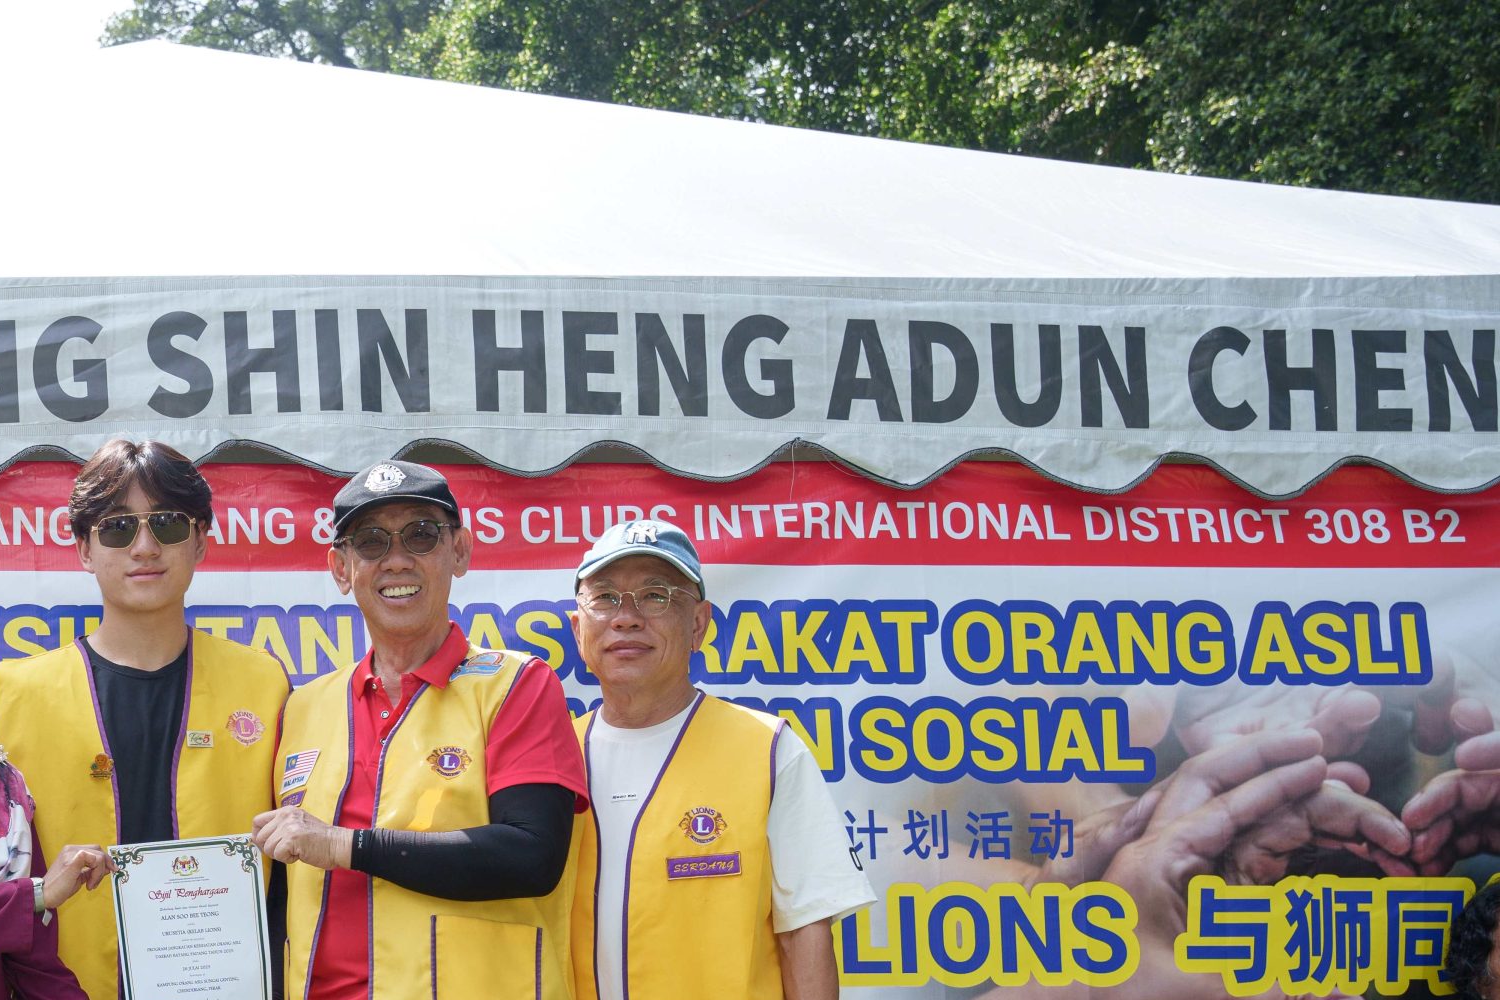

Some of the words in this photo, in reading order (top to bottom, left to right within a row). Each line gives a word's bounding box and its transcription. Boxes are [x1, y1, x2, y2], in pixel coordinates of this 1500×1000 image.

[147, 309, 431, 420] SHIN
[472, 309, 796, 421] HENG
[827, 318, 1150, 430] ADUN
[695, 501, 1071, 543] INTERNATIONAL
[1084, 504, 1290, 545] DISTRICT
[1304, 508, 1391, 545] 308
[1404, 508, 1467, 544] B2
[951, 609, 1227, 677] ORANG
[1249, 611, 1422, 676] ASLI
[443, 754, 456, 769] L
[860, 707, 1145, 772] SOSIAL
[691, 807, 716, 816] LIONS
[696, 816, 710, 834] L
[845, 810, 1074, 861] 计划活动
[673, 859, 735, 873] SERDANG
[175, 886, 229, 900] Penghargaan
[841, 894, 1128, 975] LIONS
